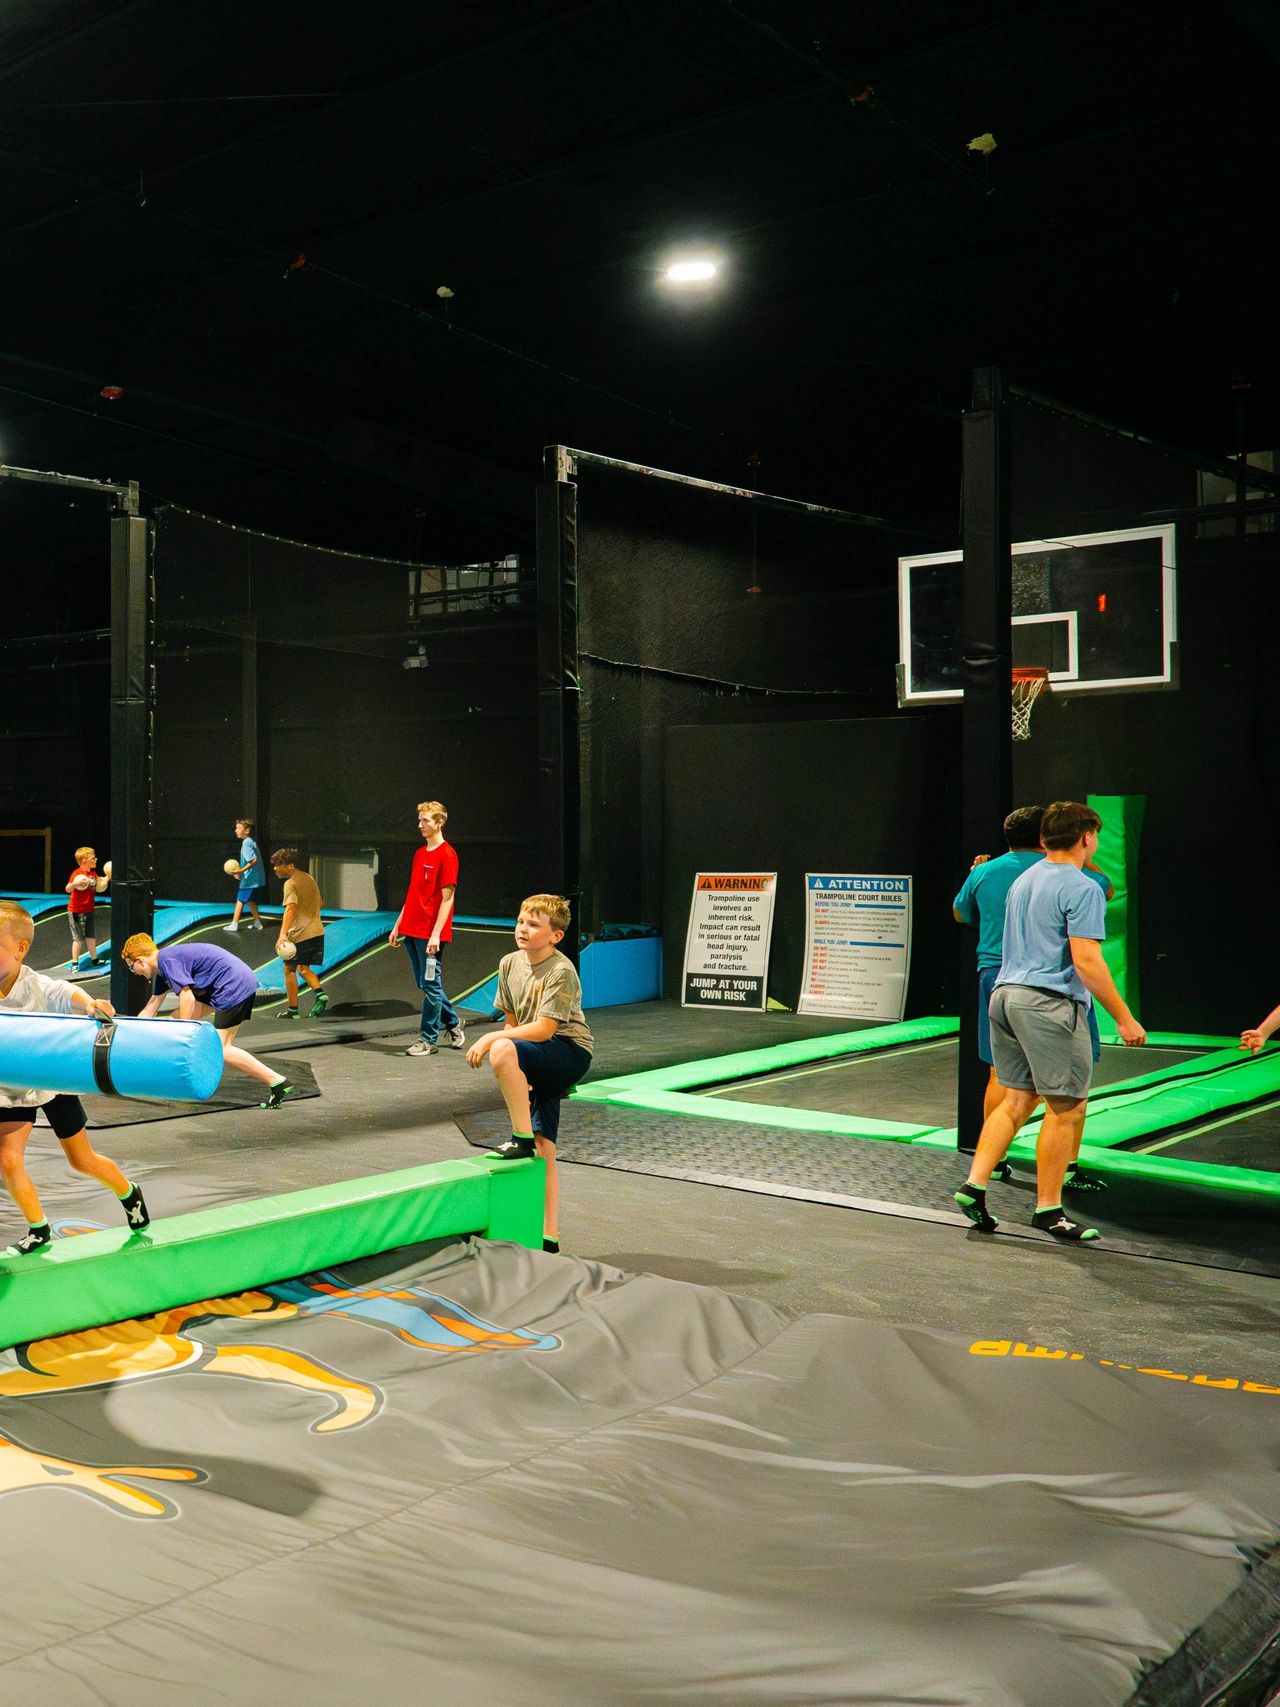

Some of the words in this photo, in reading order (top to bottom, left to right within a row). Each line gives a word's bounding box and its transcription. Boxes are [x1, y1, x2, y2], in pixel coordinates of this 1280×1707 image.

[829, 880, 903, 890] ATTENTION
[700, 923, 723, 931] Impact
[710, 953, 742, 961] paralysis
[690, 978, 717, 987] JUMP
[719, 980, 730, 988] AT
[733, 980, 757, 990] YOUR
[700, 990, 721, 999] OWN
[724, 991, 746, 1001] RISK
